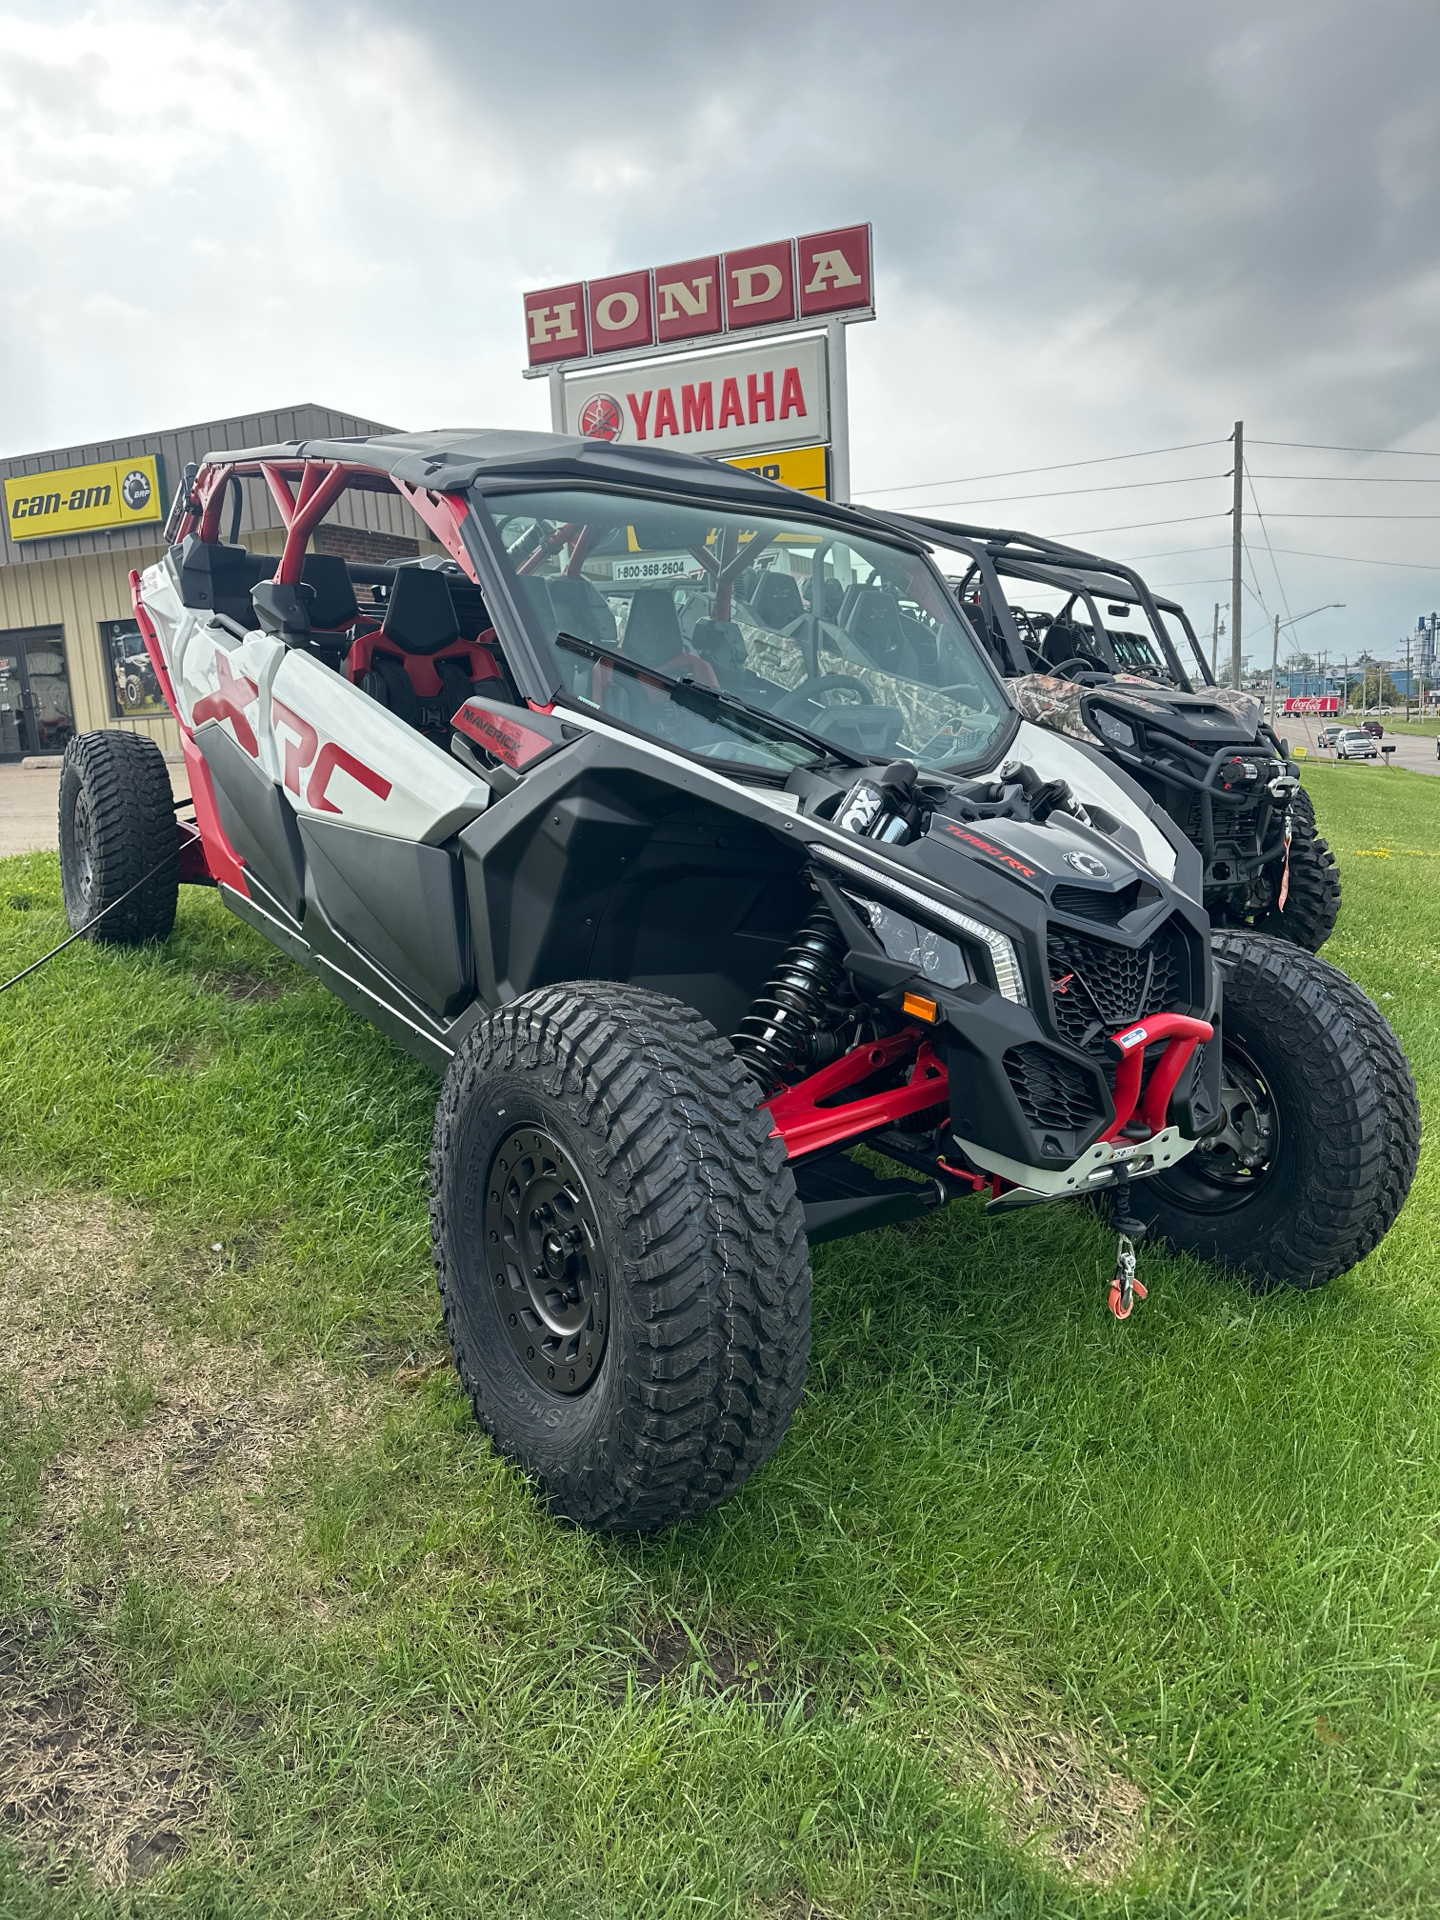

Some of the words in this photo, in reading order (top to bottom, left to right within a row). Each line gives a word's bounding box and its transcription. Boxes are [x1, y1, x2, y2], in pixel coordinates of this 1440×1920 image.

[528, 249, 862, 346] HONDA
[626, 367, 807, 440] YAMAHA
[12, 484, 111, 519] can-am
[133, 489, 150, 499] BRP
[617, 561, 684, 579] 1-800-368-2604
[462, 707, 523, 755] MAVERICK
[945, 823, 1003, 856] TURBO
[998, 854, 1036, 878] RR
